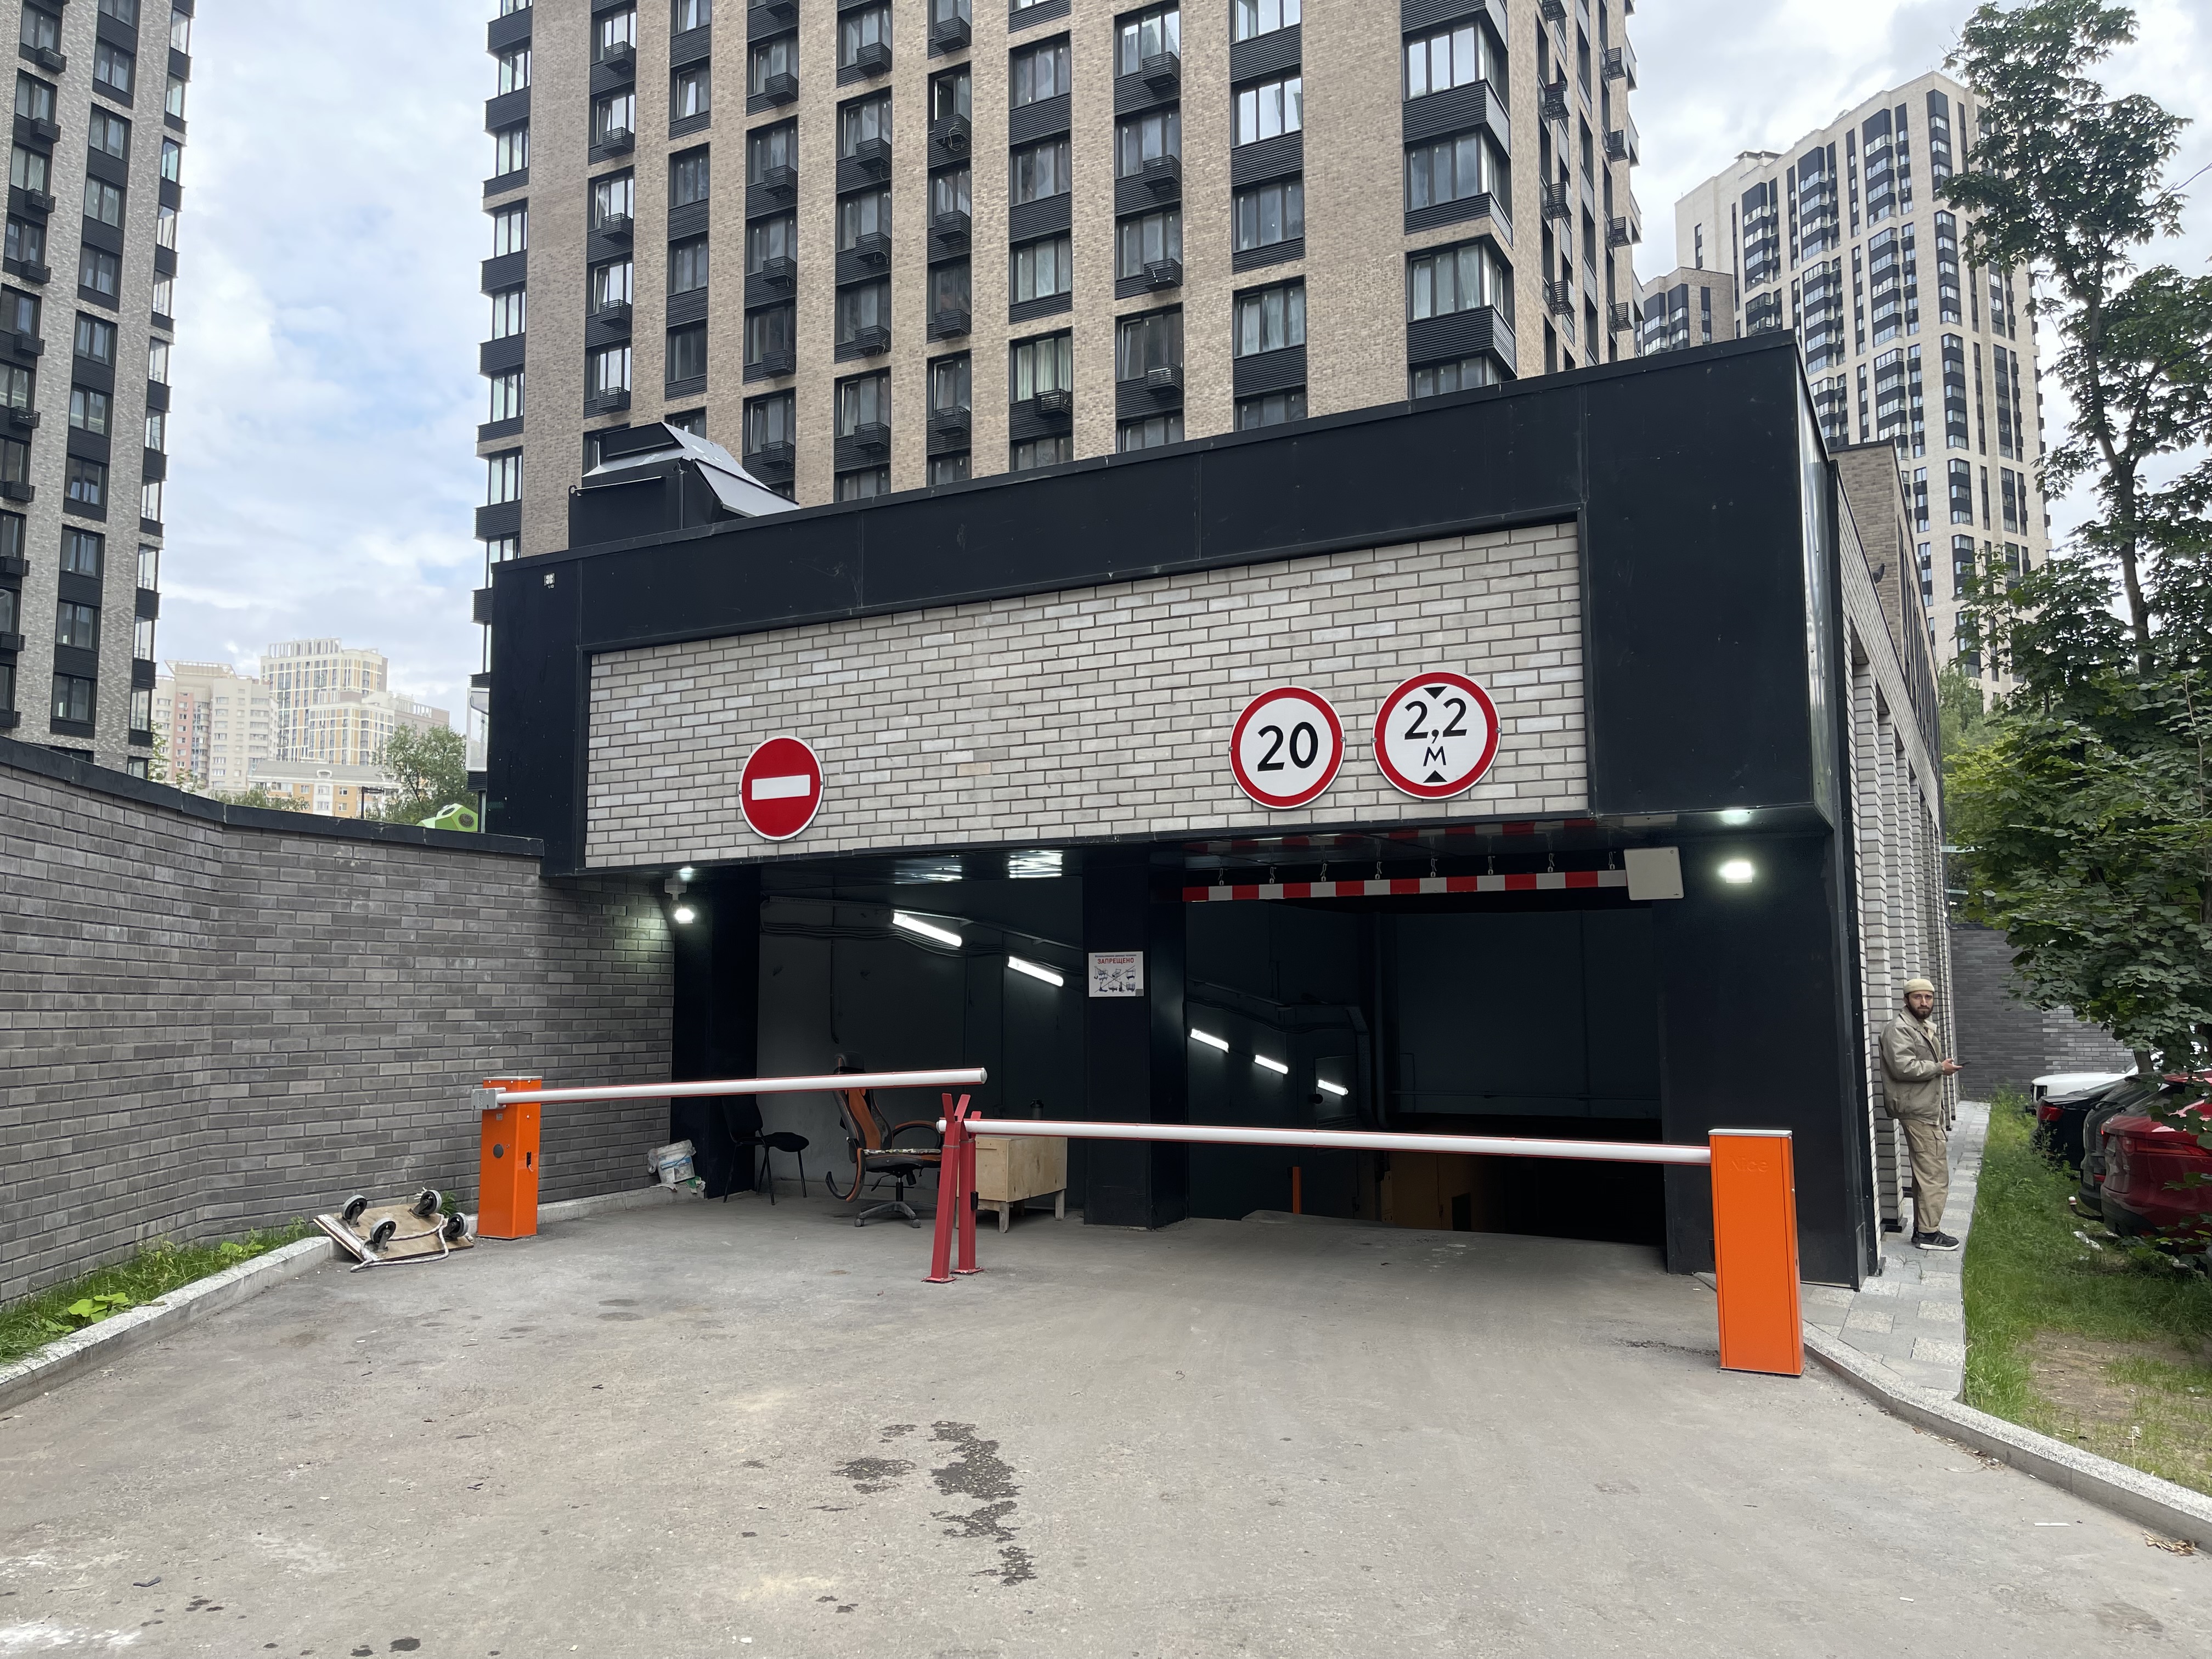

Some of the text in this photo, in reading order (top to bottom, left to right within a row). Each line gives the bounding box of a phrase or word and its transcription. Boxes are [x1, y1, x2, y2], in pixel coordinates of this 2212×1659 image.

[1404, 697, 1468, 744] 2,2
[1257, 721, 1318, 772] 20
[1729, 1155, 1769, 1172] Nice
